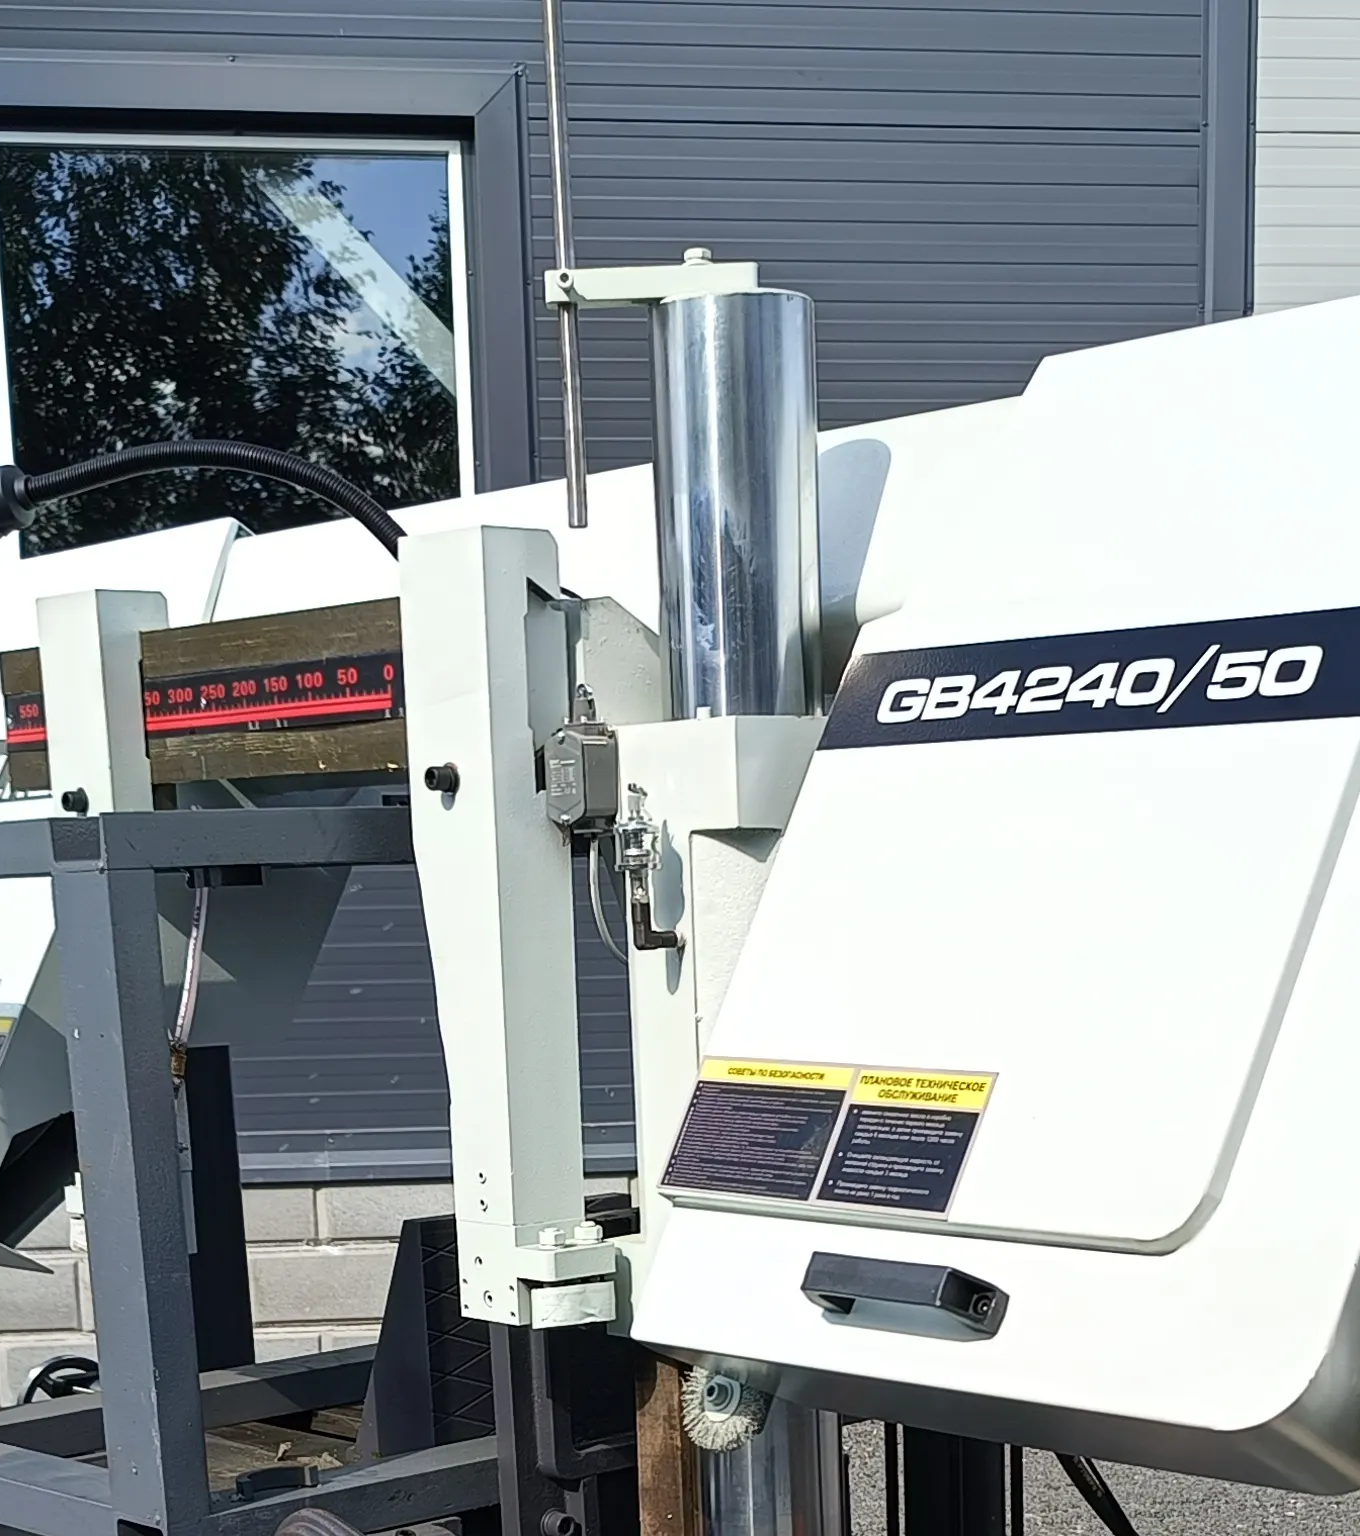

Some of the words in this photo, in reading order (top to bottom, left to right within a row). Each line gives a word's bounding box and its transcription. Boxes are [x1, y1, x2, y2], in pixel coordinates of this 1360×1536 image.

[144, 690, 161, 706] 50
[167, 688, 193, 704] 300
[200, 683, 225, 701] 250
[232, 679, 257, 697] 200
[263, 675, 288, 692] 150
[295, 671, 323, 689] 100
[337, 668, 358, 685] 50
[383, 664, 394, 681] 0
[876, 644, 1324, 724] GB4240/50
[727, 1067, 757, 1076] СОВЕТЫ
[860, 1075, 914, 1088] ПЛАНОВОЕ
[915, 1078, 987, 1092] ТЕХНИЧЕСКОЕ
[878, 1089, 959, 1103] ОБСЛУЖИВАНИЕ
